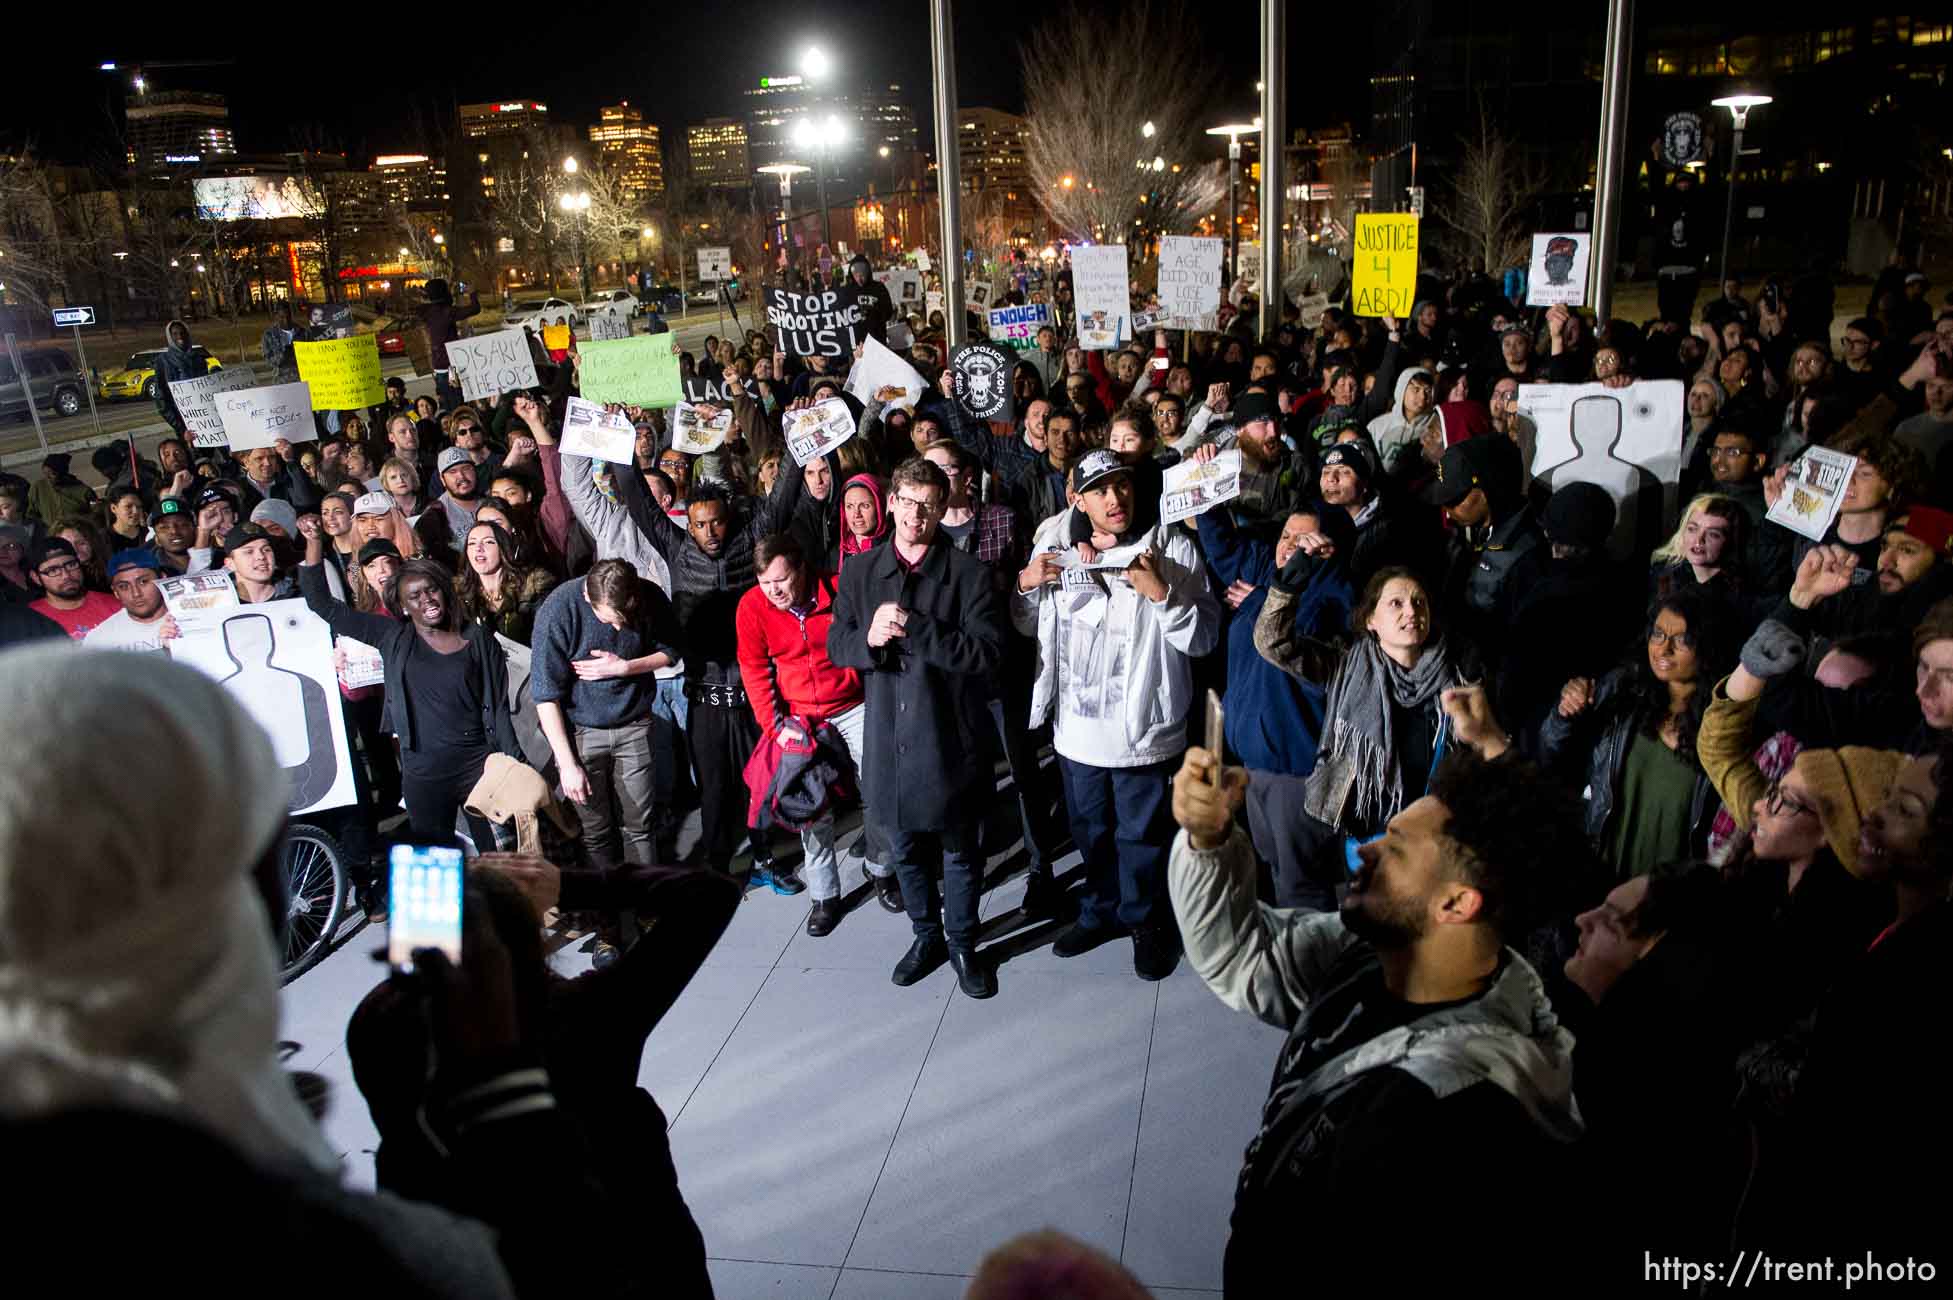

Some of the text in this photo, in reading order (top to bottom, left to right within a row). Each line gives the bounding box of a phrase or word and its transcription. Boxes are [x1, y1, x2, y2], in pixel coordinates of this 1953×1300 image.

[1164, 238, 1218, 253] AT WHAT
[1357, 223, 1416, 251] JUSTICE
[1175, 255, 1202, 269] AGE
[1373, 256, 1391, 283] 4
[1160, 271, 1214, 285] DID YOU
[774, 289, 838, 313] STOP
[1357, 287, 1408, 314] ABDI
[767, 304, 861, 331] SHOOTING
[989, 304, 1048, 326] ENOUGH
[1007, 324, 1029, 337] IS
[452, 334, 526, 375] DISARM
[954, 346, 1006, 365] THE POLICE
[172, 382, 185, 395] AT
[462, 365, 532, 400] THE COPS
[682, 378, 758, 402] LACK
[955, 372, 963, 395] ARE
[997, 371, 1006, 394] NOT
[175, 396, 193, 407] NOT
[975, 398, 1006, 418] FRIENDS
[181, 408, 209, 420] WHITE
[196, 431, 226, 446] MATT
[1815, 462, 1842, 492] STOP
